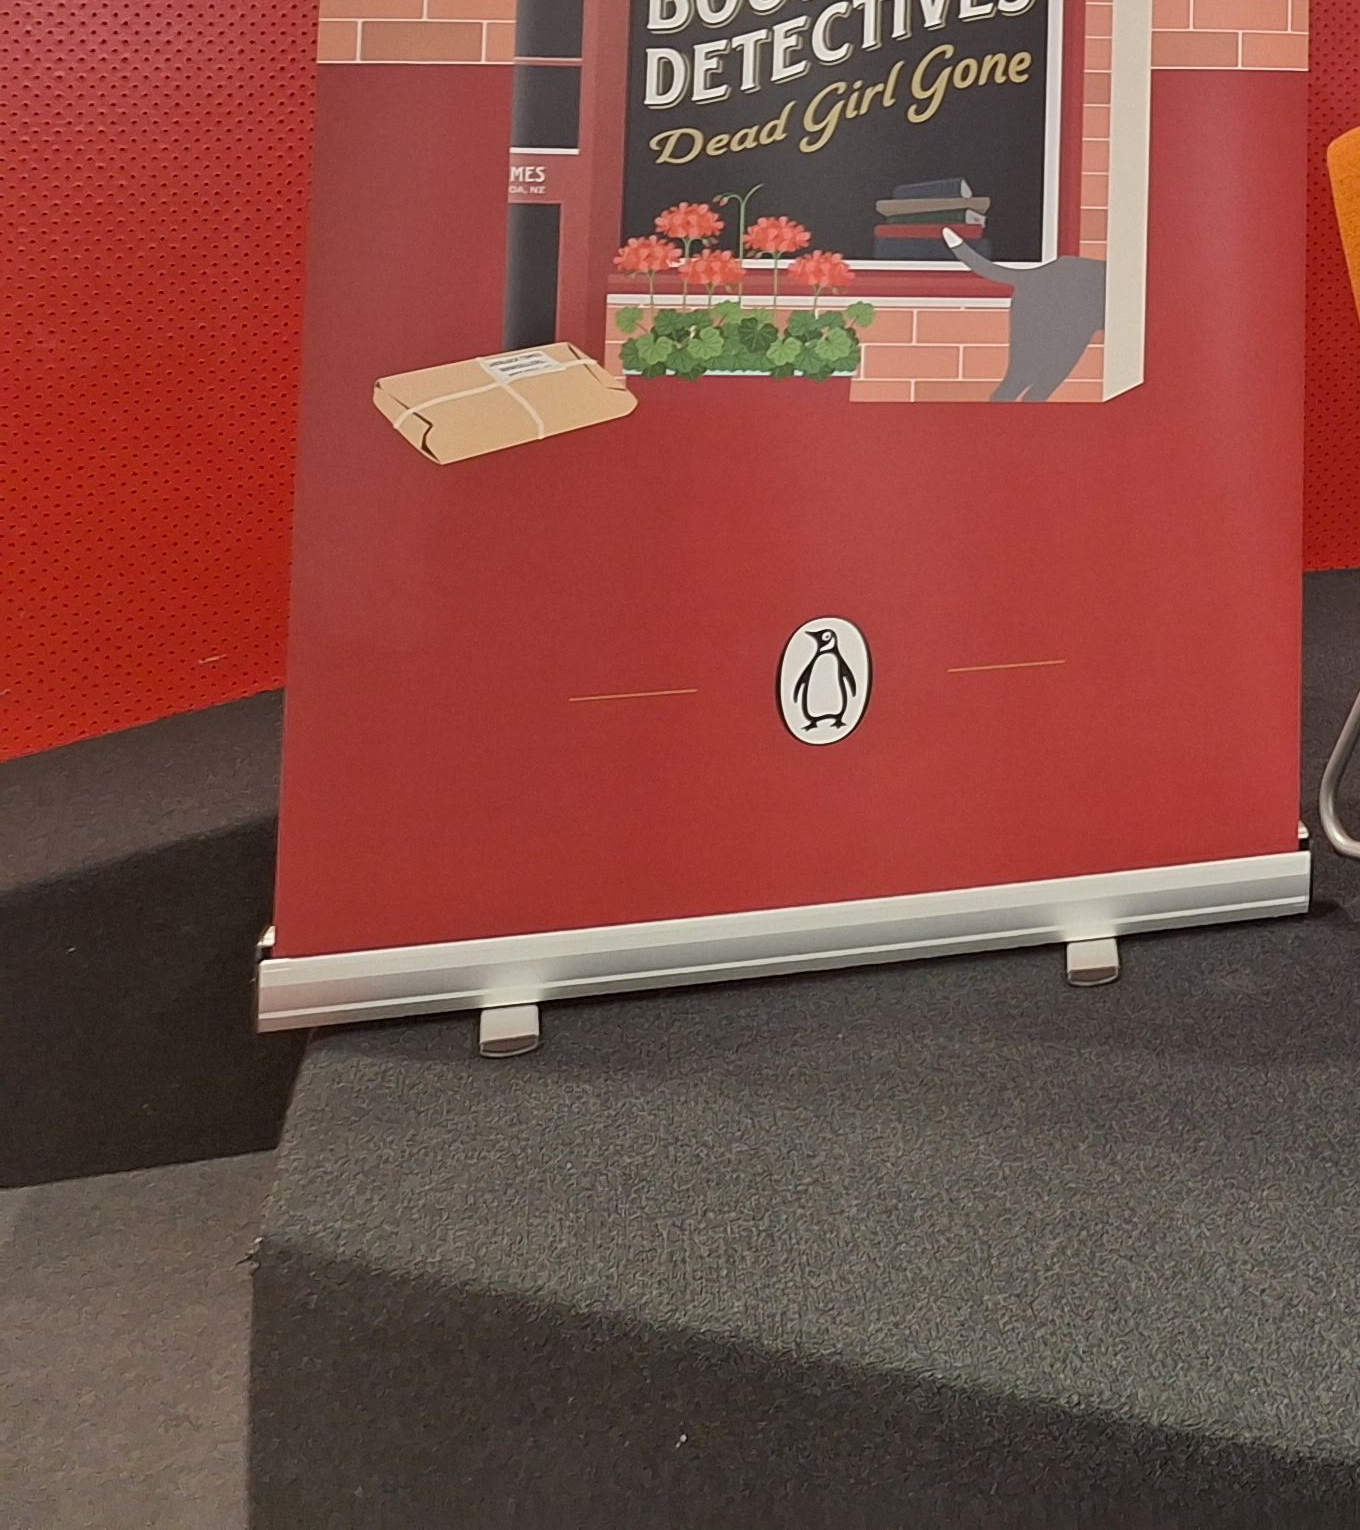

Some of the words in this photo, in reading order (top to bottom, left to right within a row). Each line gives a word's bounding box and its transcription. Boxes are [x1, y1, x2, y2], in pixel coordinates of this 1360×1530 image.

[648, 100, 798, 165] Dead
[799, 60, 904, 153] Girl
[906, 43, 1032, 124] Gone
[510, 166, 546, 183] MES
